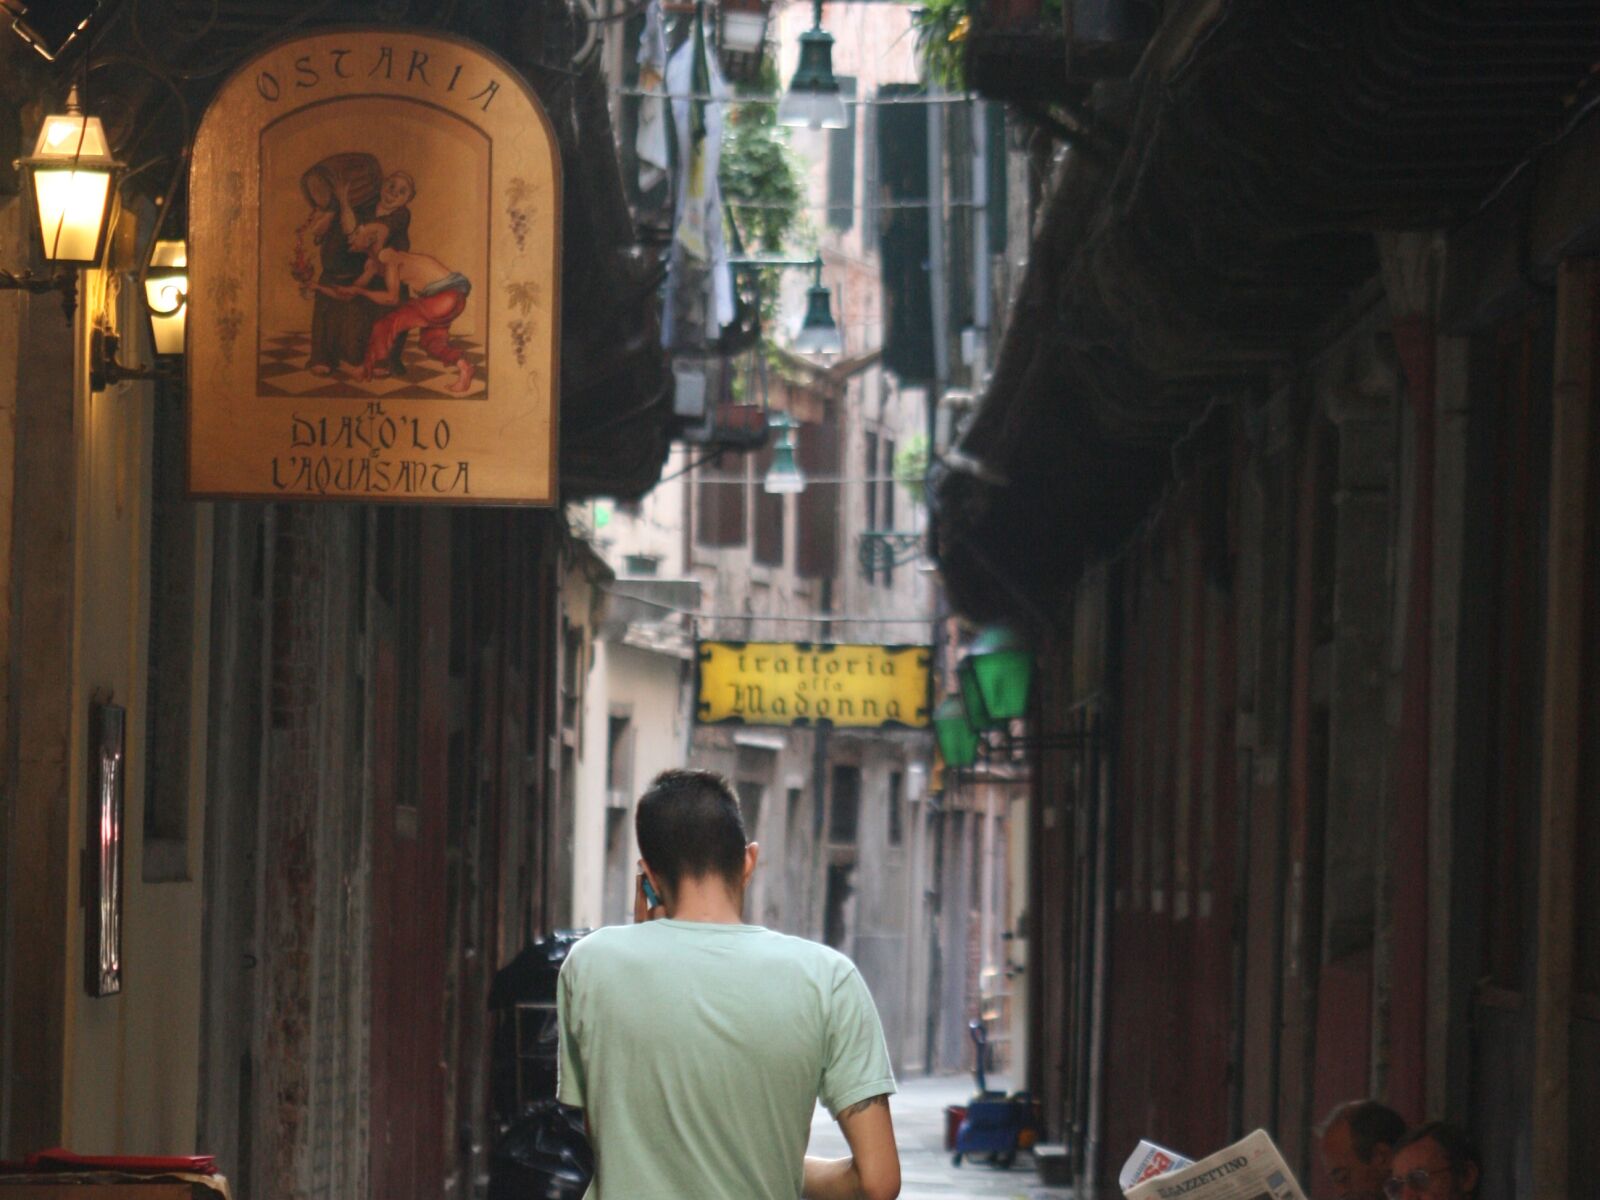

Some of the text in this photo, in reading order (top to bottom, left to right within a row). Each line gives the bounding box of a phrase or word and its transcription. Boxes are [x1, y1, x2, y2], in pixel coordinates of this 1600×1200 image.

[256, 47, 500, 112] OSTARIA
[362, 401, 385, 416] AL
[737, 653, 897, 677] trattoria
[728, 680, 902, 719] Madonna
